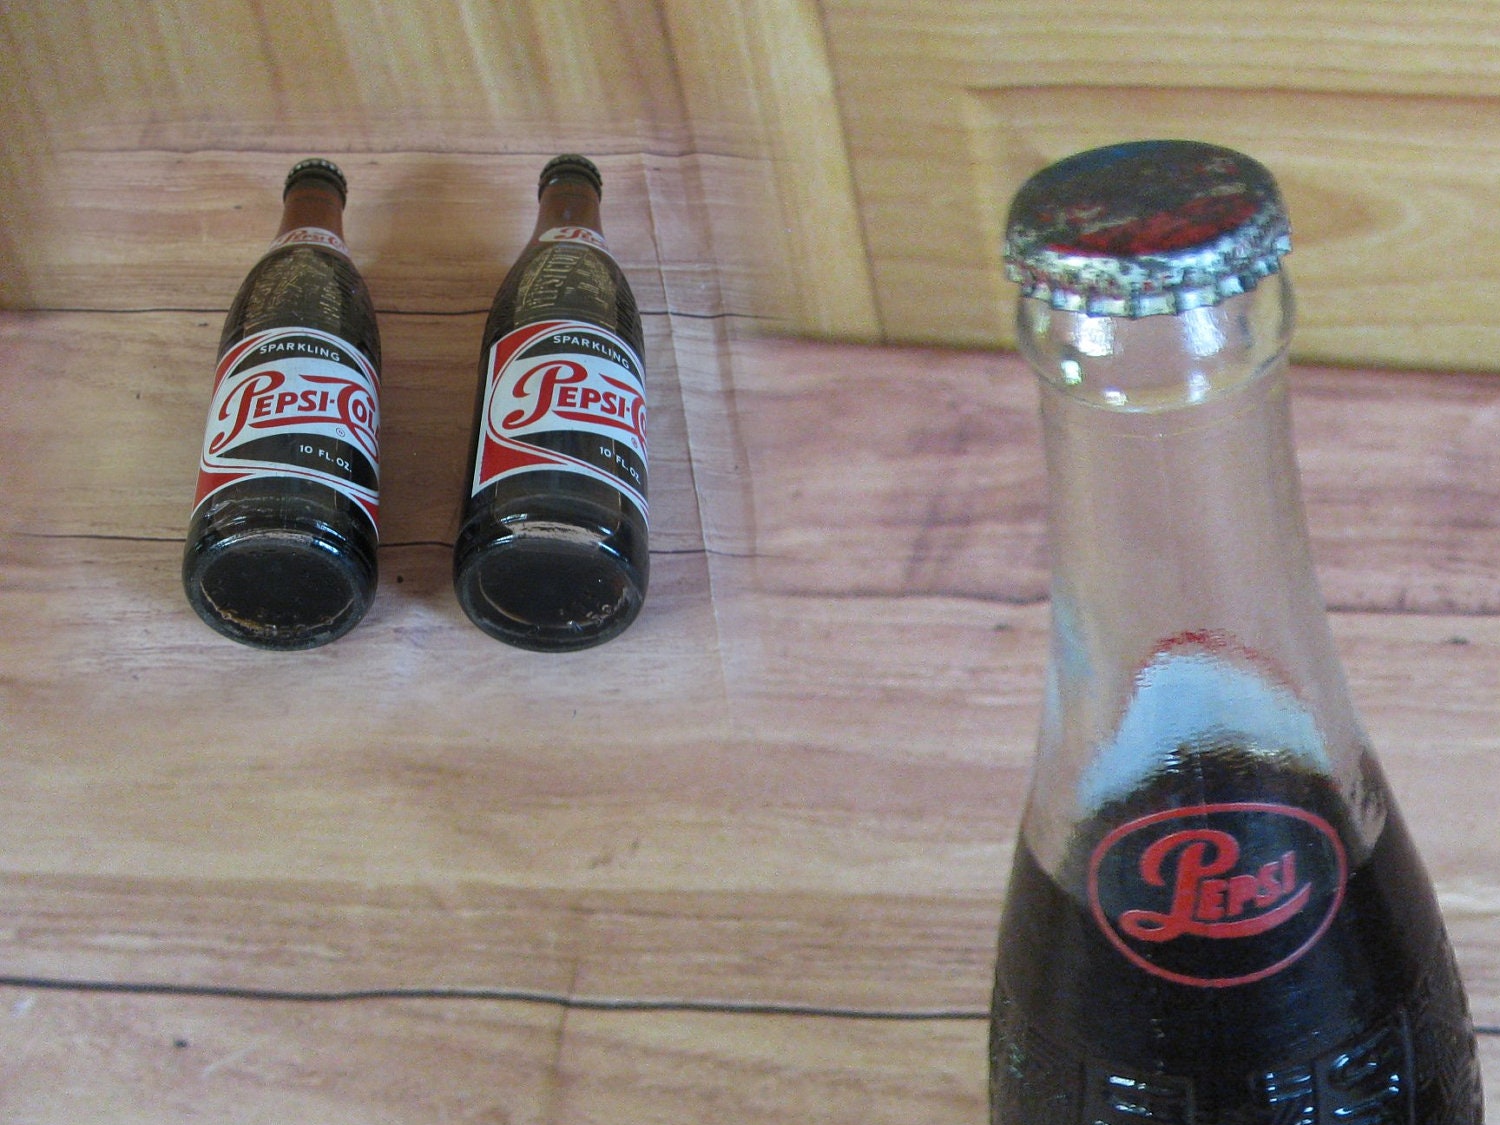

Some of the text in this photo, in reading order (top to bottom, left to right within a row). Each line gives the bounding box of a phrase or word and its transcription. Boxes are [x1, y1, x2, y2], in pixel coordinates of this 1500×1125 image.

[259, 342, 341, 362] SPARKLING
[552, 335, 630, 369] SPARKLING
[208, 370, 380, 464] PEPSI-COL
[299, 444, 353, 473] 10 FL. OZ.
[599, 446, 612, 459] 10
[615, 455, 630, 471] FL.
